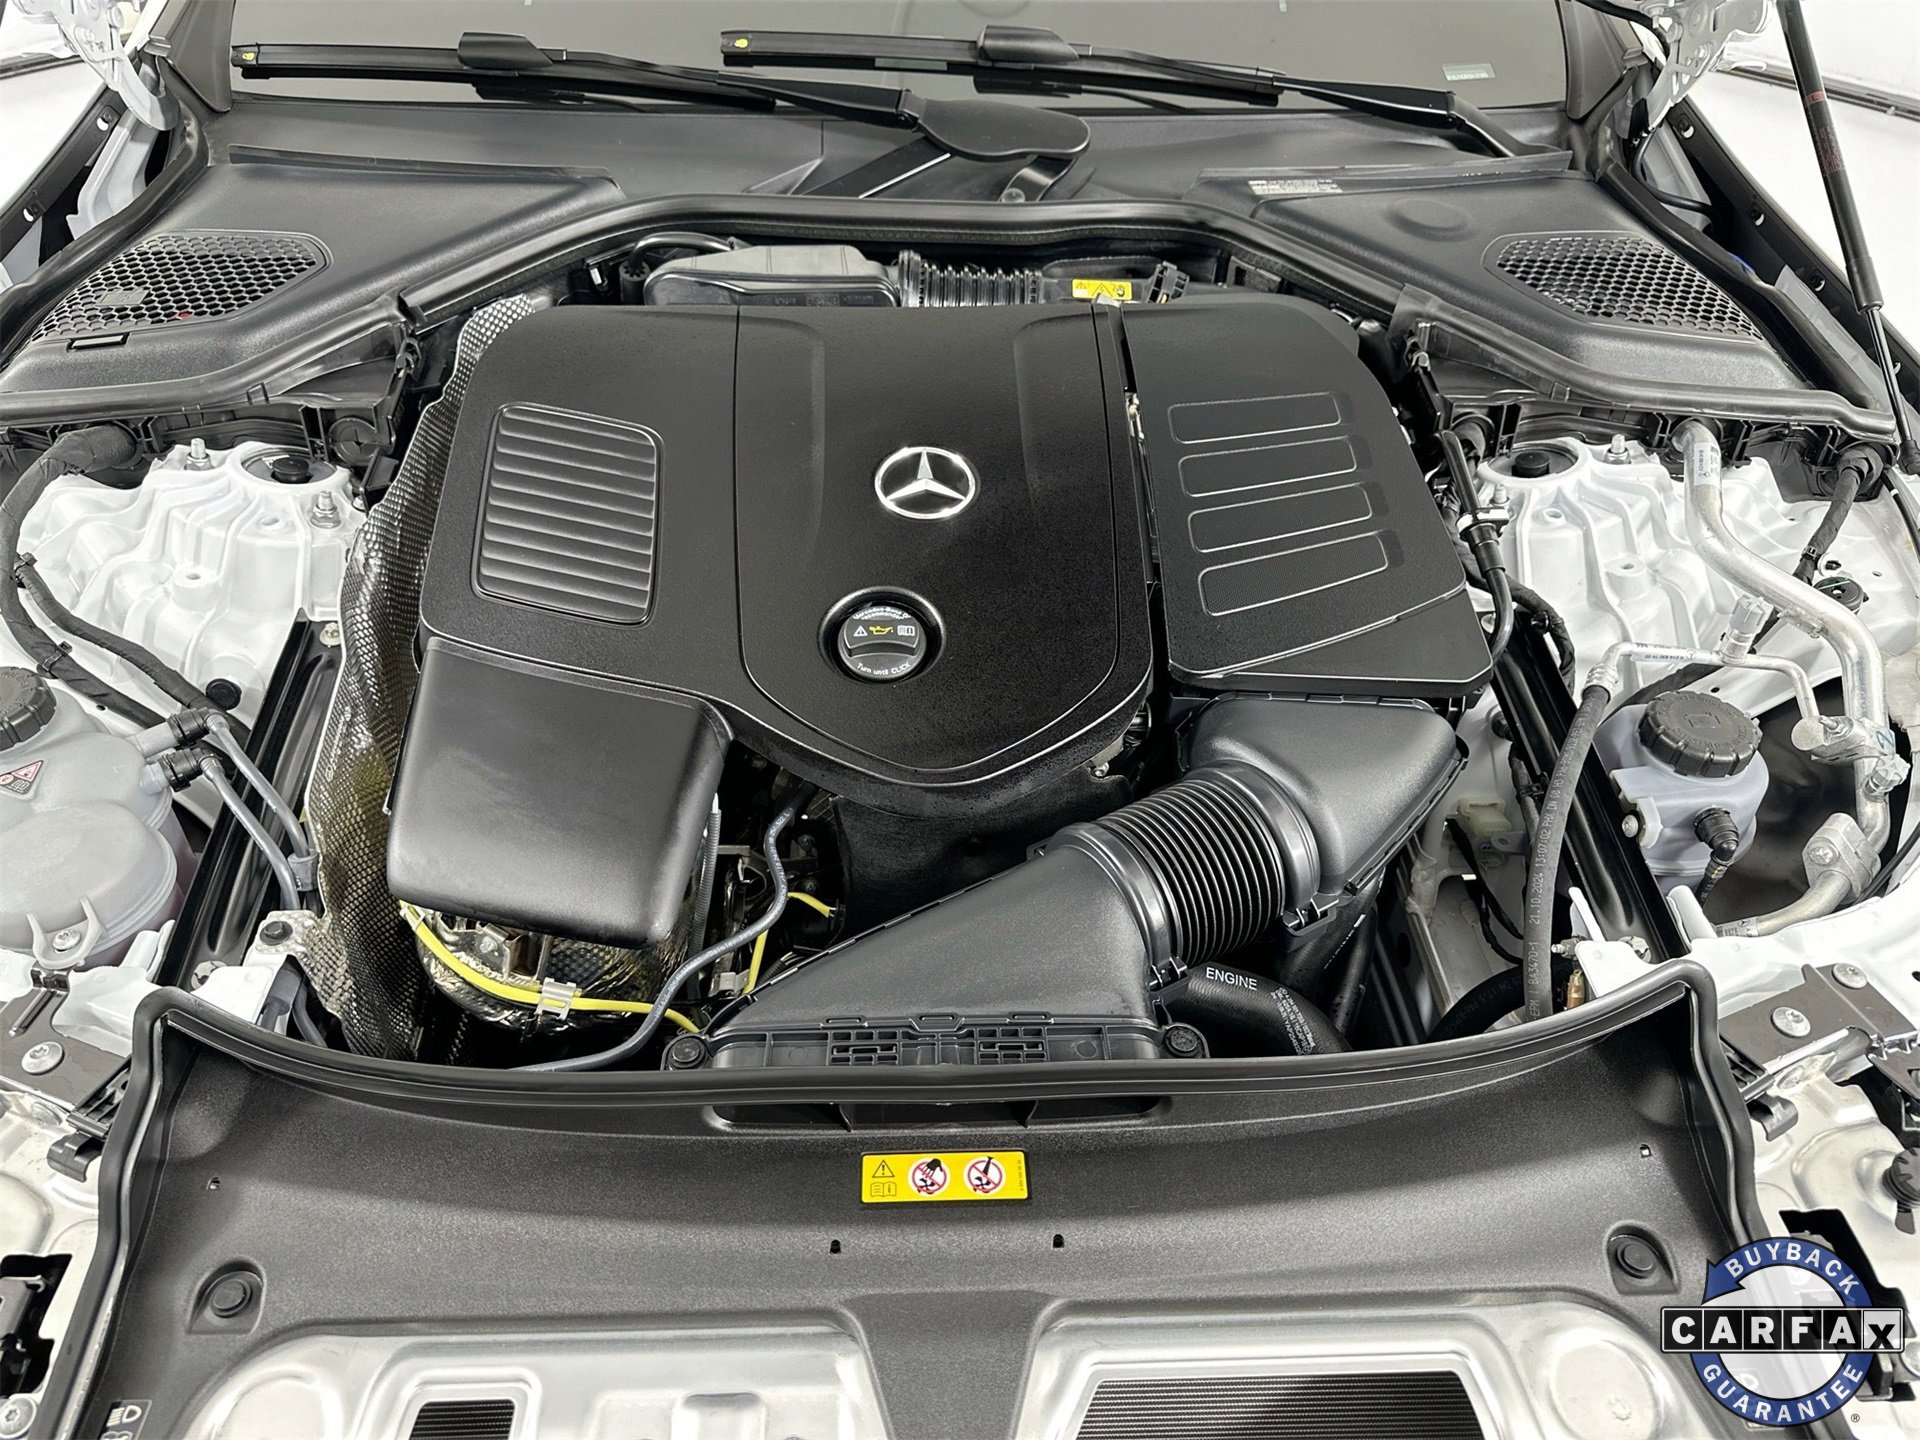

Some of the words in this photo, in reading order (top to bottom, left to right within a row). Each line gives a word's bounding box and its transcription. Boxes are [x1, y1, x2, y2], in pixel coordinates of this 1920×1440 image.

[857, 662, 872, 674] Turn
[873, 667, 888, 676] until
[891, 661, 911, 674] CLICK
[1534, 829, 1552, 867] 13:07:02
[1529, 872, 1544, 925] 21.10.2024
[1205, 966, 1258, 992] ENGINE
